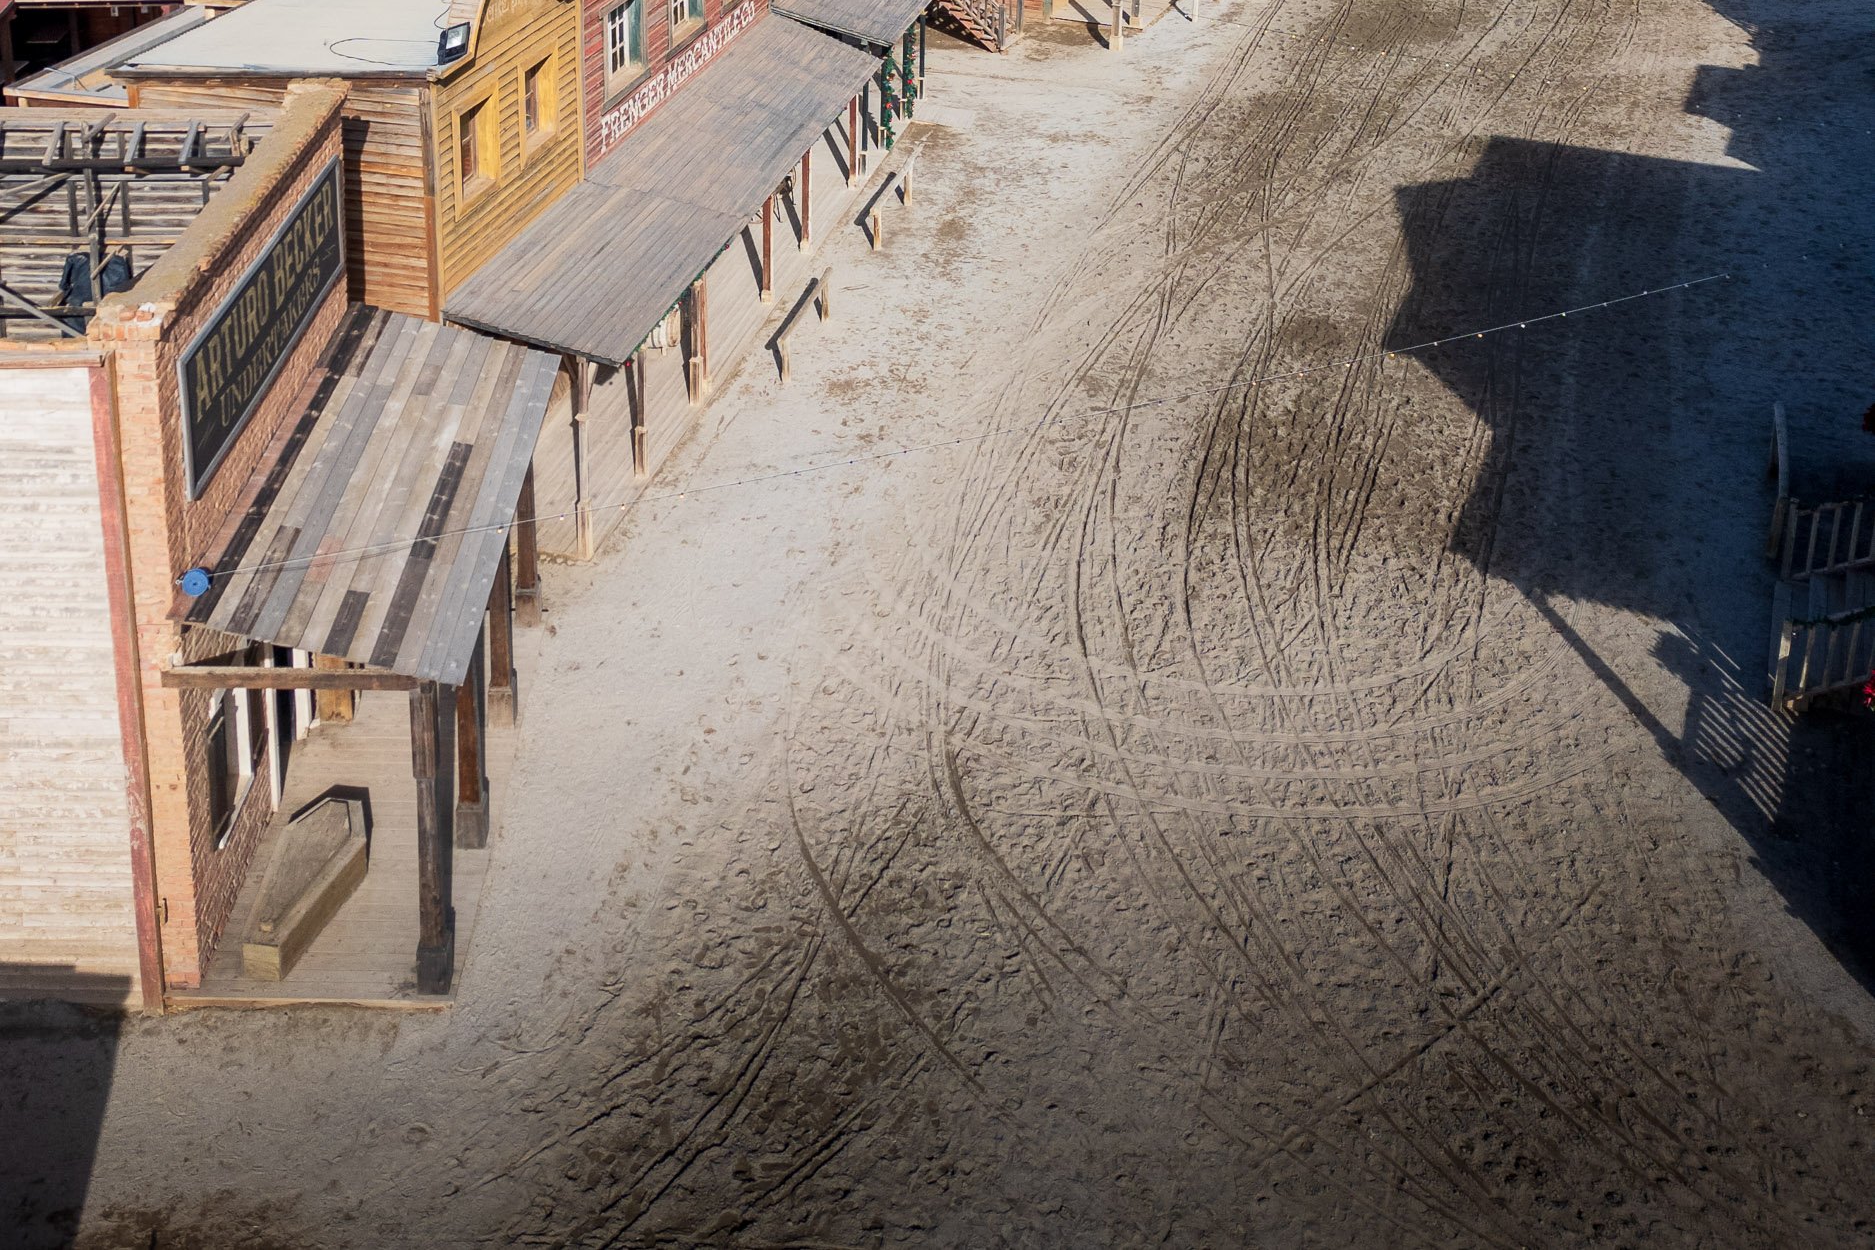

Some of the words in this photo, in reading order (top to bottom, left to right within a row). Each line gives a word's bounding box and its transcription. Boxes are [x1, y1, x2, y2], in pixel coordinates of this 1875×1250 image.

[665, 8, 741, 97] MERCANTILE
[196, 273, 270, 423] ARTURO
[271, 180, 334, 302] BECKER
[220, 257, 321, 428] UNDERTAKERS
